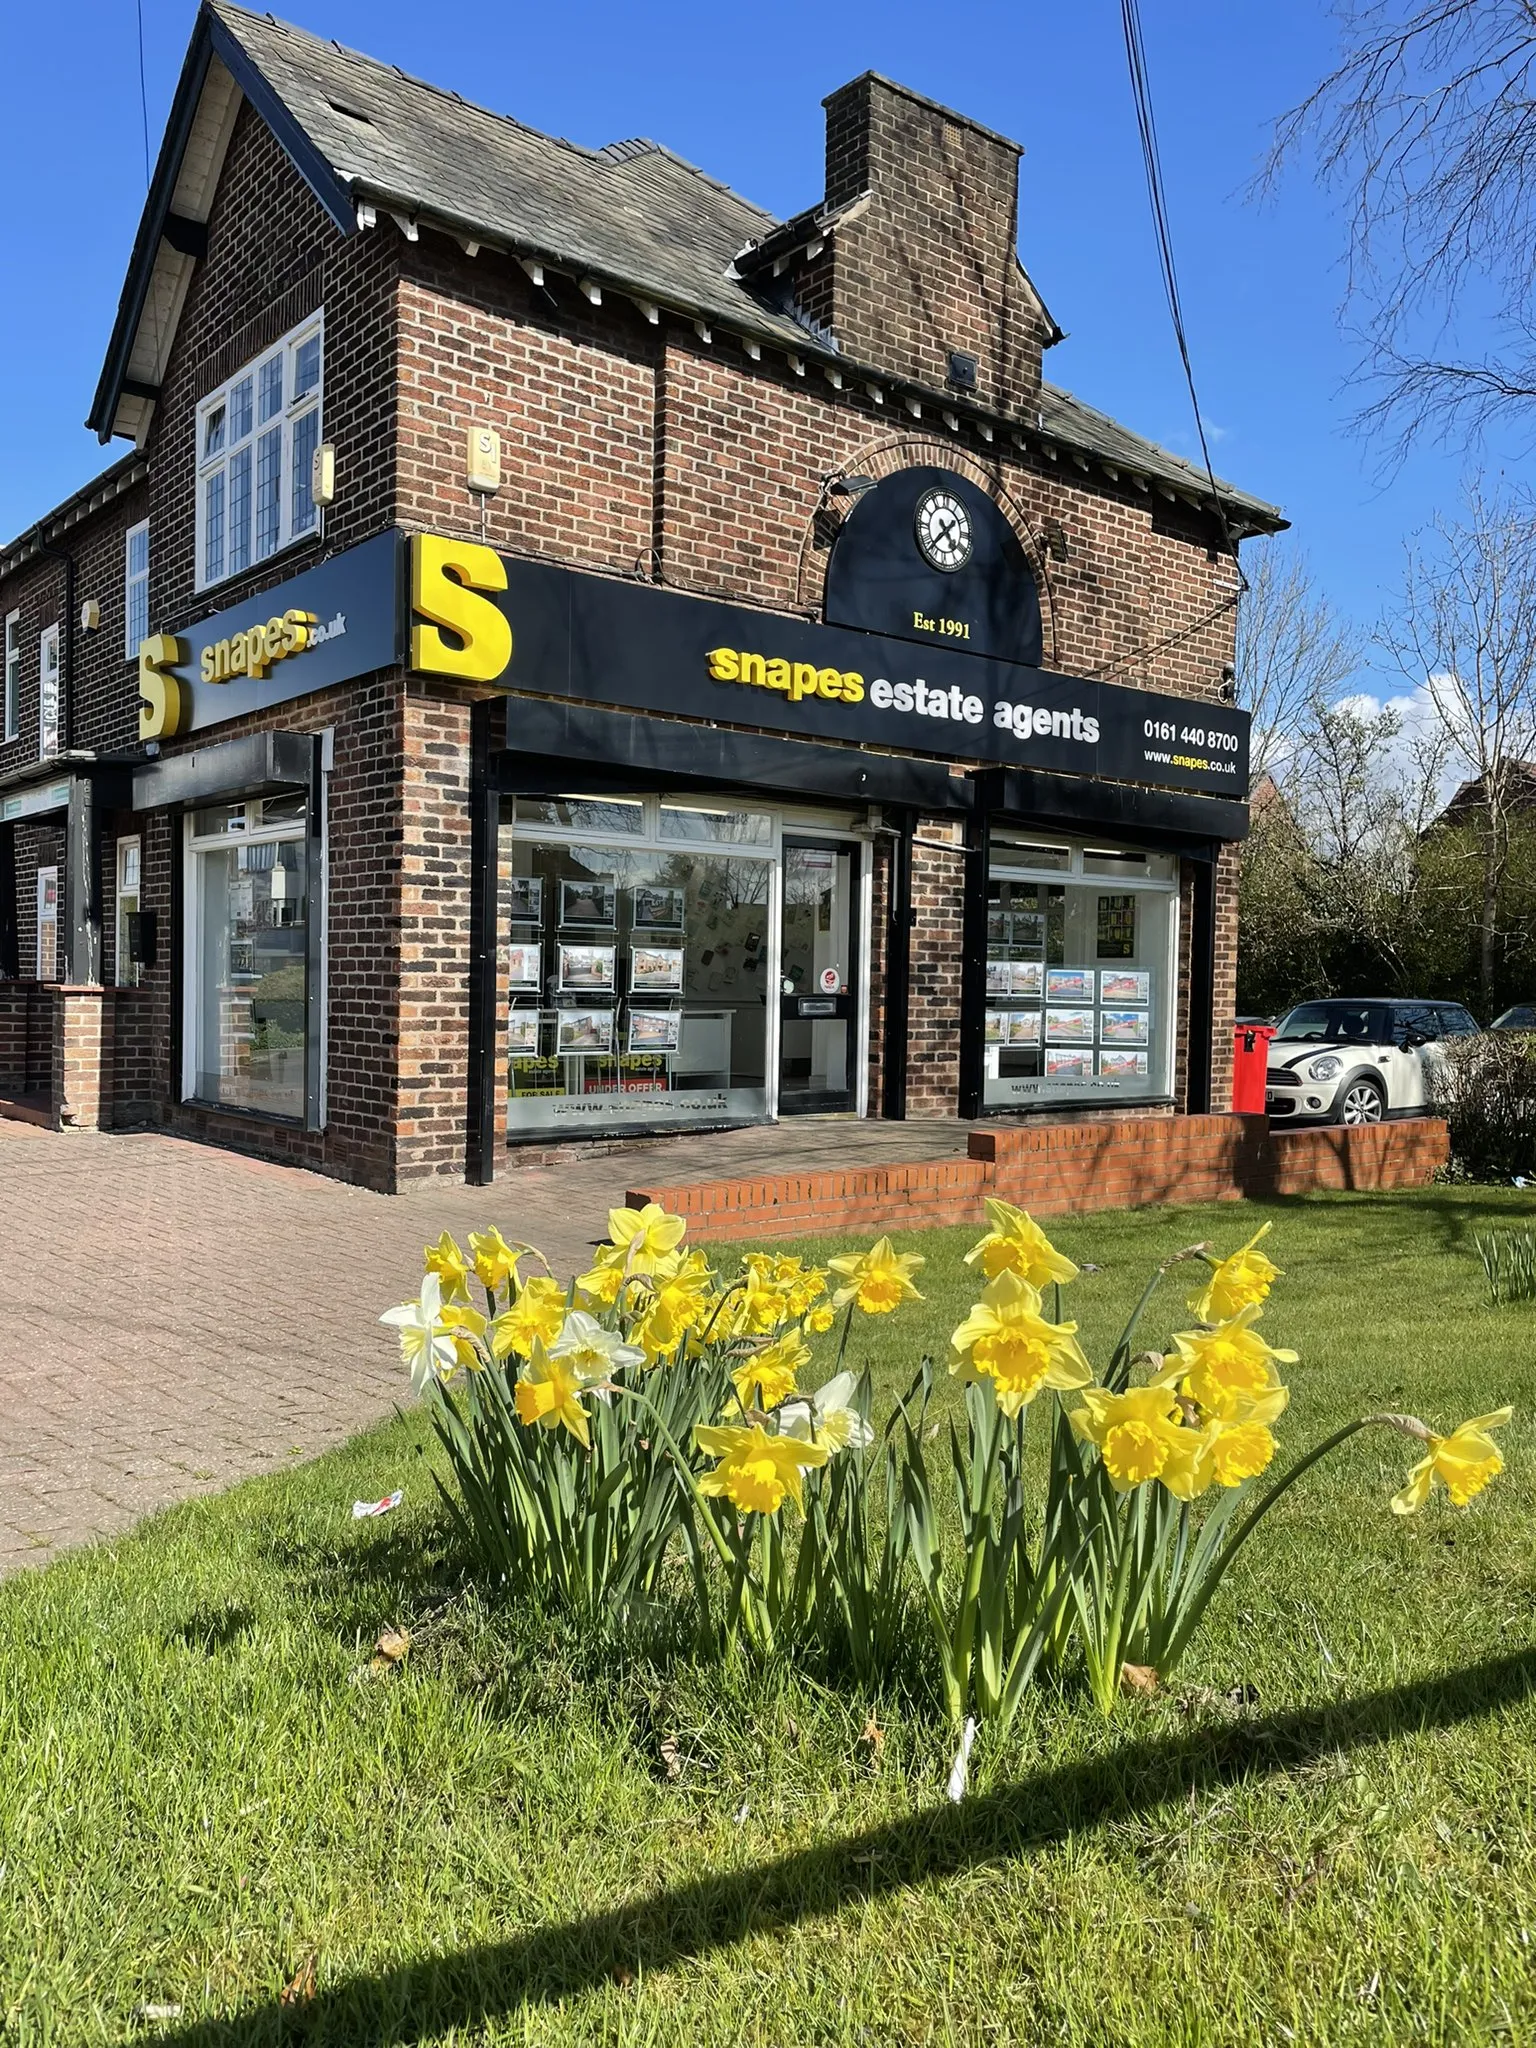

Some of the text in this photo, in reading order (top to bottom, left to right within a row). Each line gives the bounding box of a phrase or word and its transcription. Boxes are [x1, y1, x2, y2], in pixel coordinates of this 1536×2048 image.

[411, 534, 513, 682] S
[913, 611, 971, 639] Est 1991
[139, 633, 181, 742] S
[705, 647, 1101, 744] snapes estate agents
[1144, 719, 1238, 752] 0161 440 8700
[1144, 750, 1236, 774] www.snapes.co.uk
[512, 1055, 559, 1073] apes
